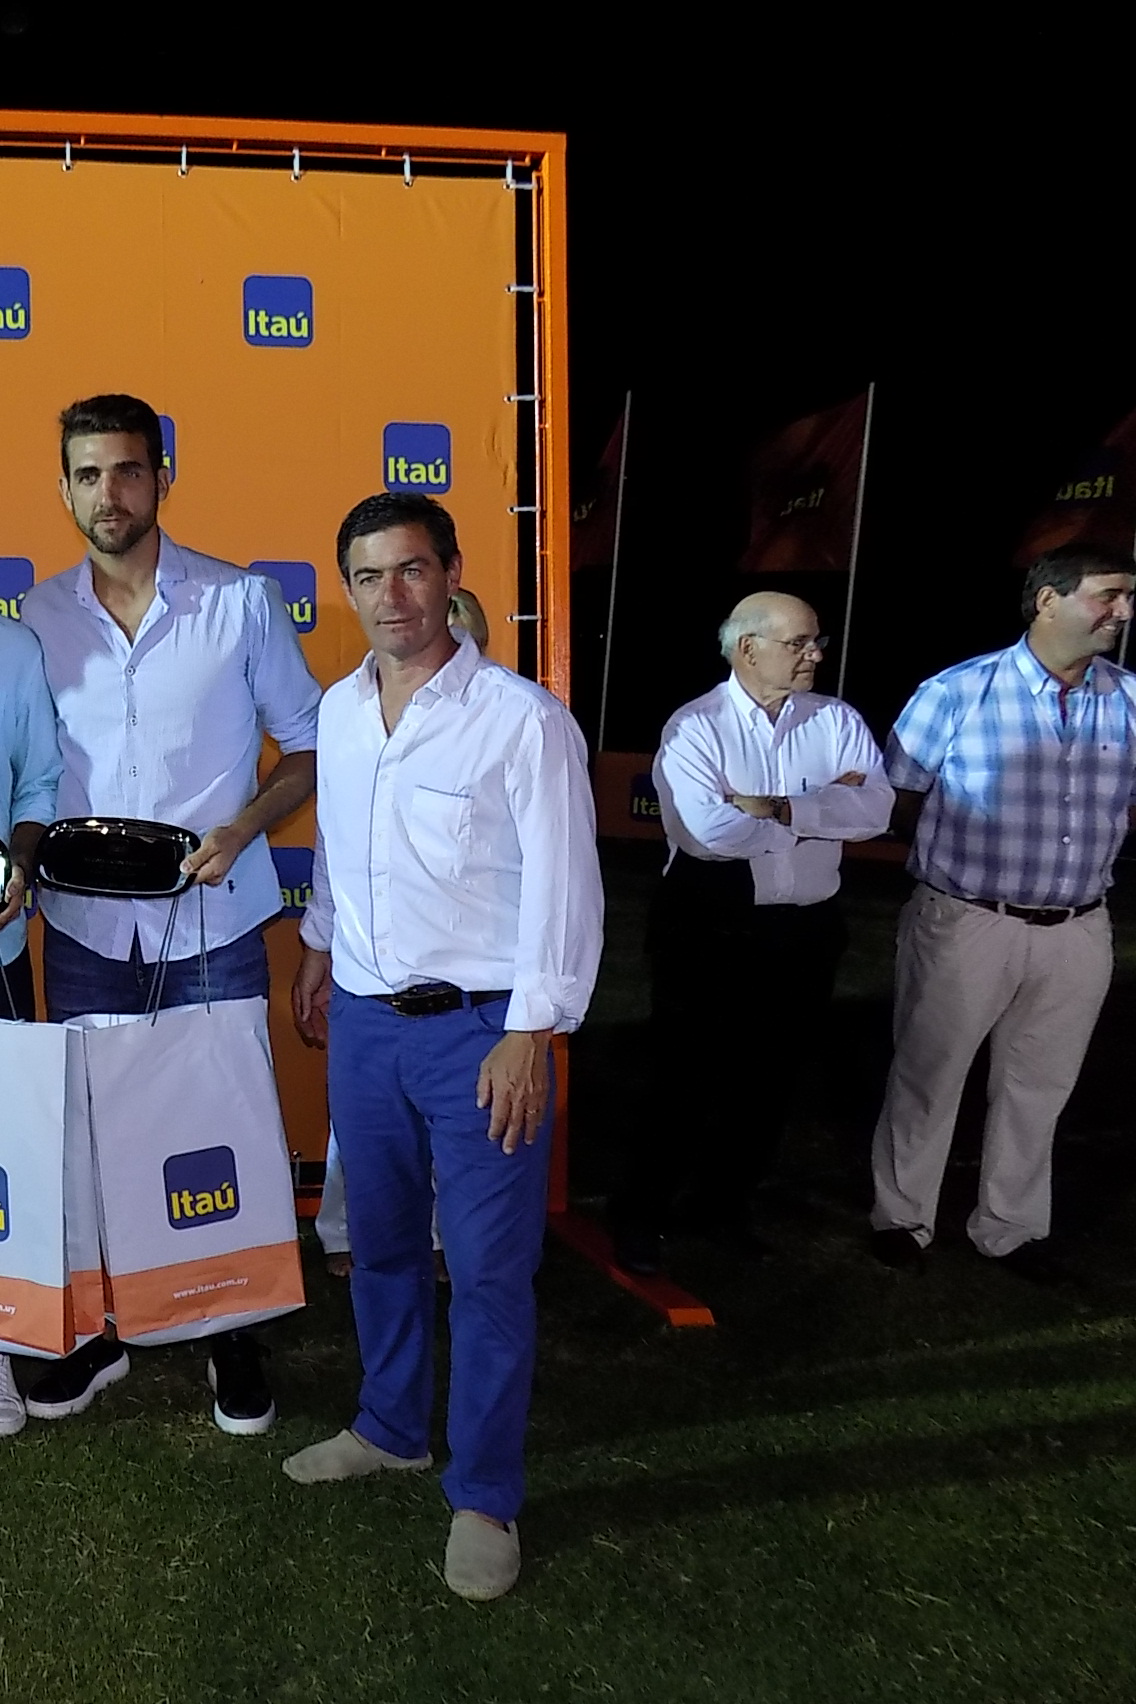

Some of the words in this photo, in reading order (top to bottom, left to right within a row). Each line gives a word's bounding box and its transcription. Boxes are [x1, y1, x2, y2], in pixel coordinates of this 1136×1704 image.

[248, 308, 311, 339] Itaú
[387, 455, 449, 485] Itaú
[633, 797, 661, 816] Ita
[171, 1181, 237, 1220] Itaú
[173, 1277, 249, 1300] www.itau.com.uy
